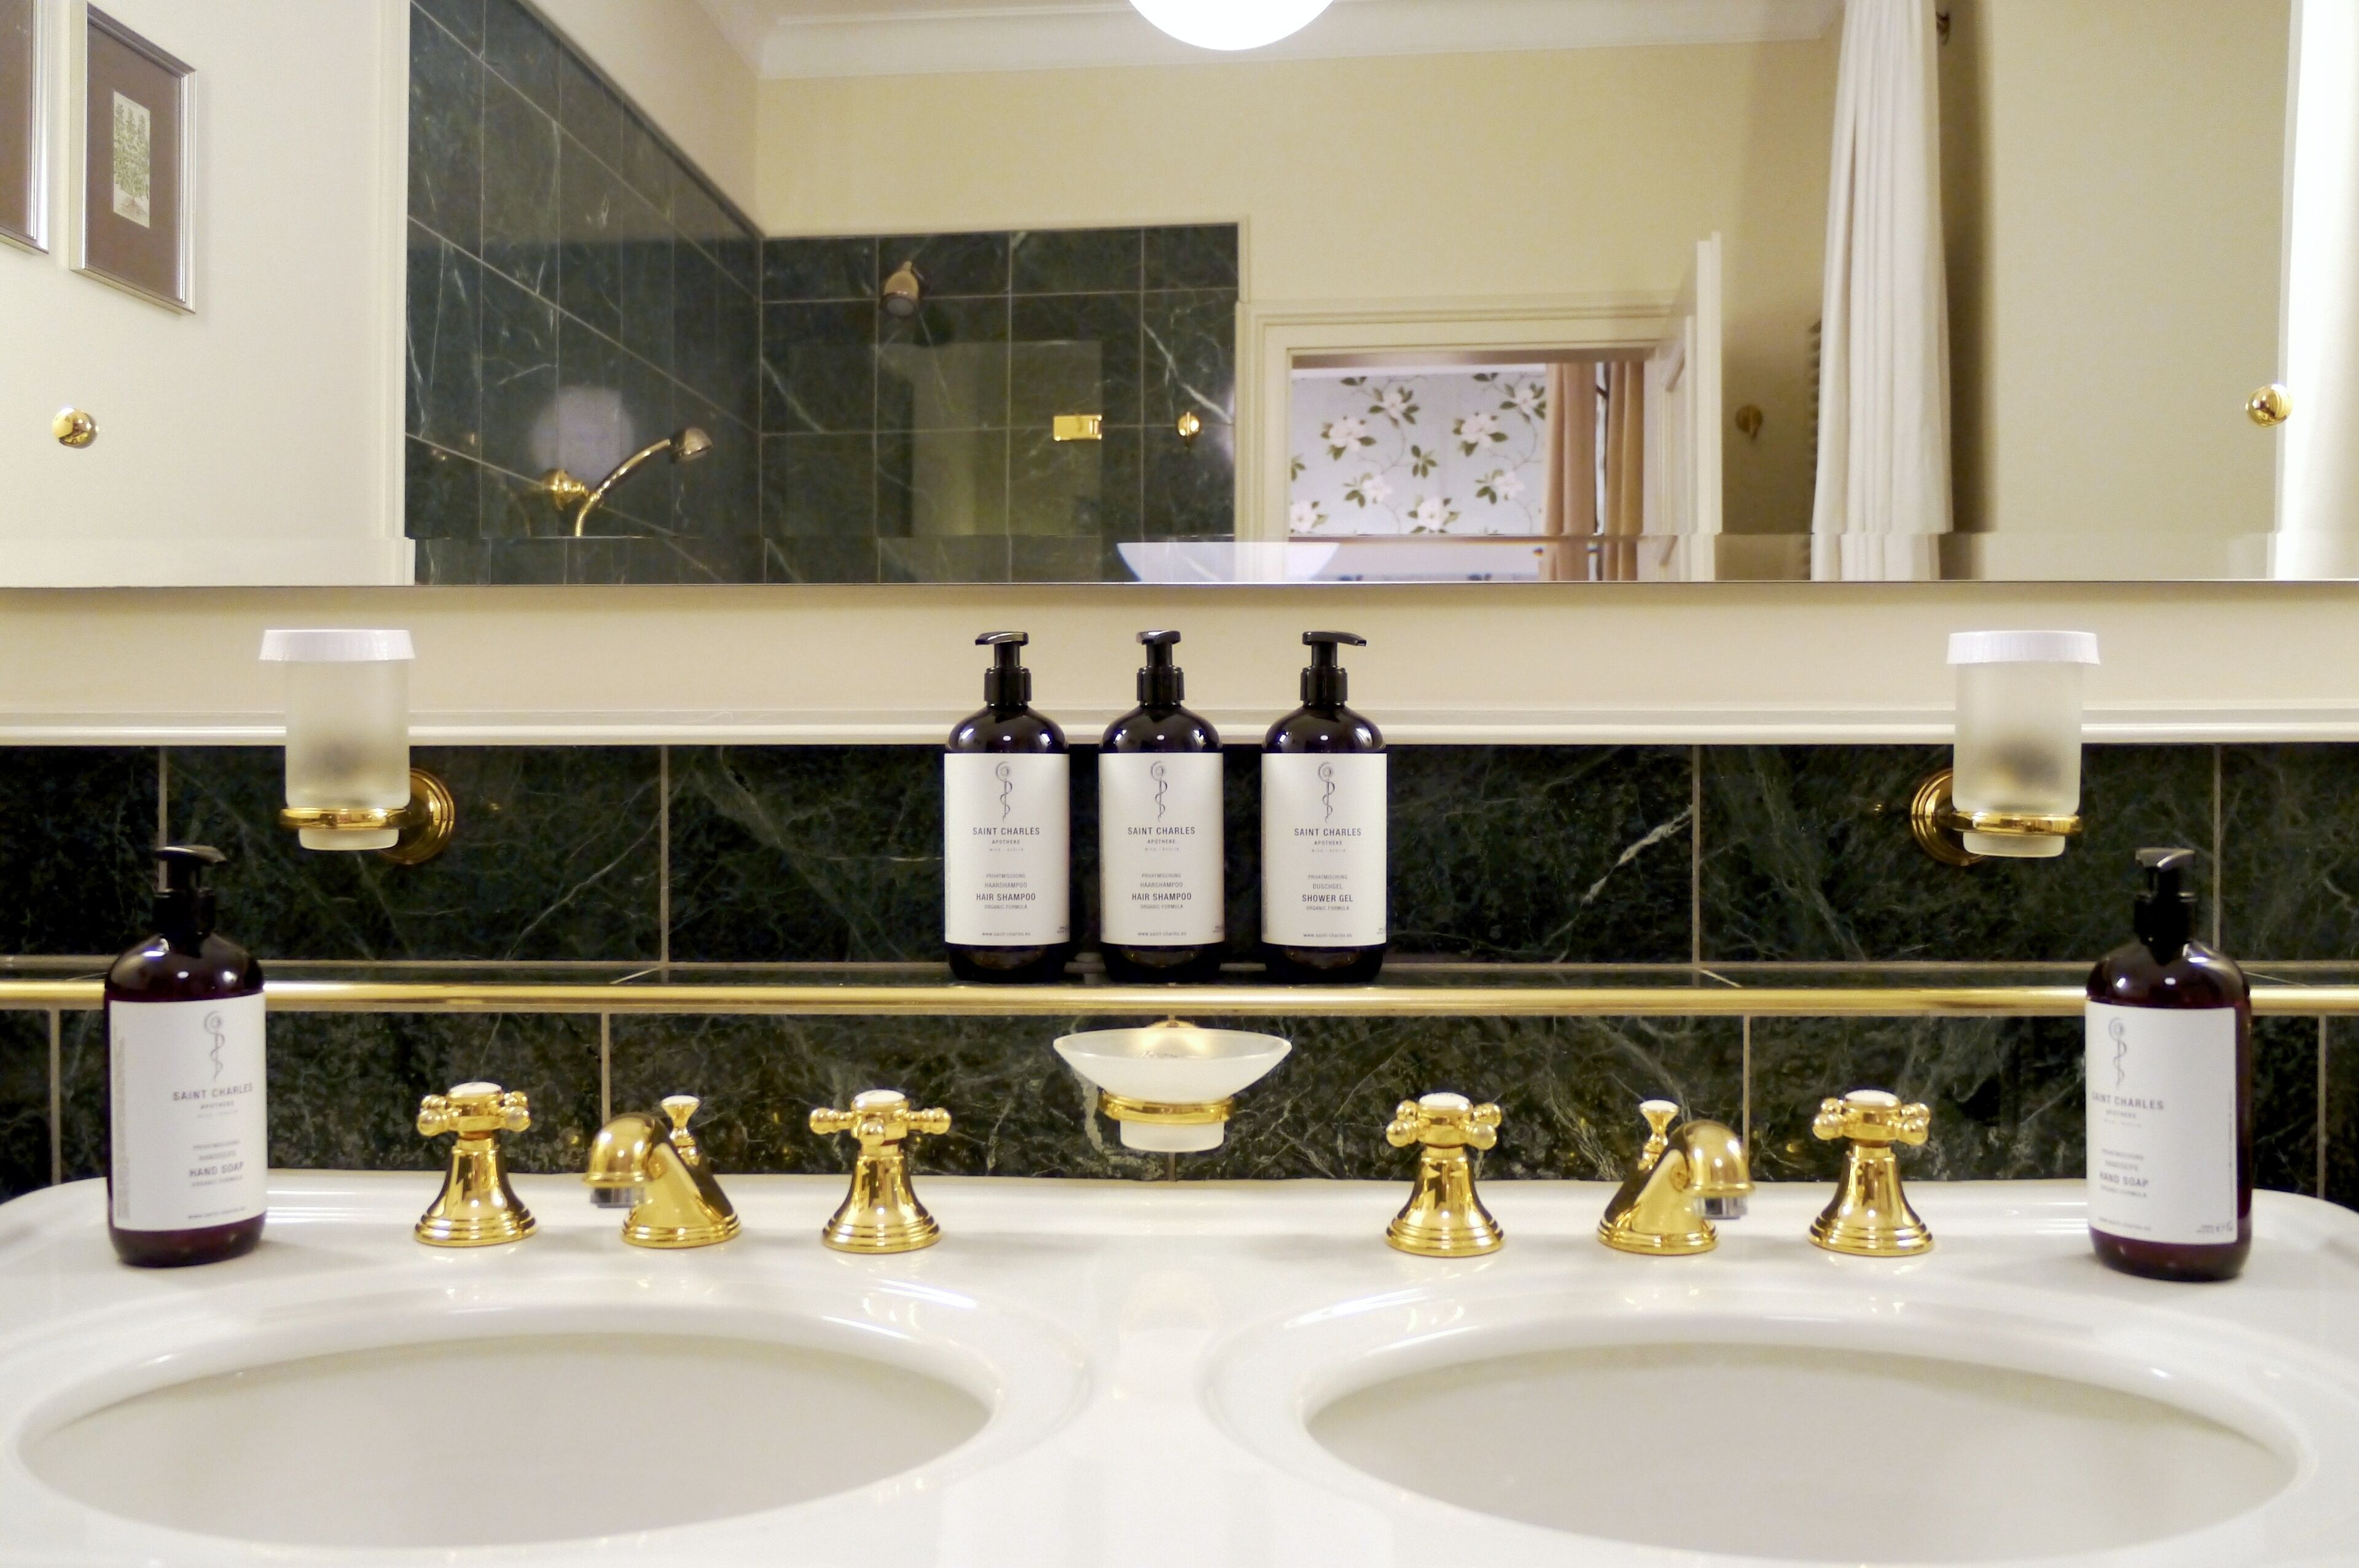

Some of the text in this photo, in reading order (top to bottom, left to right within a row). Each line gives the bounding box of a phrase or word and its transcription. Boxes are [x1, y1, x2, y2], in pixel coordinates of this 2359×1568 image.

[173, 1082, 254, 1101] SAINT CHARLES
[2114, 1096, 2164, 1110] CHARLES
[188, 1161, 245, 1177] HAND SOAP
[2123, 1176, 2149, 1187] SOAP
